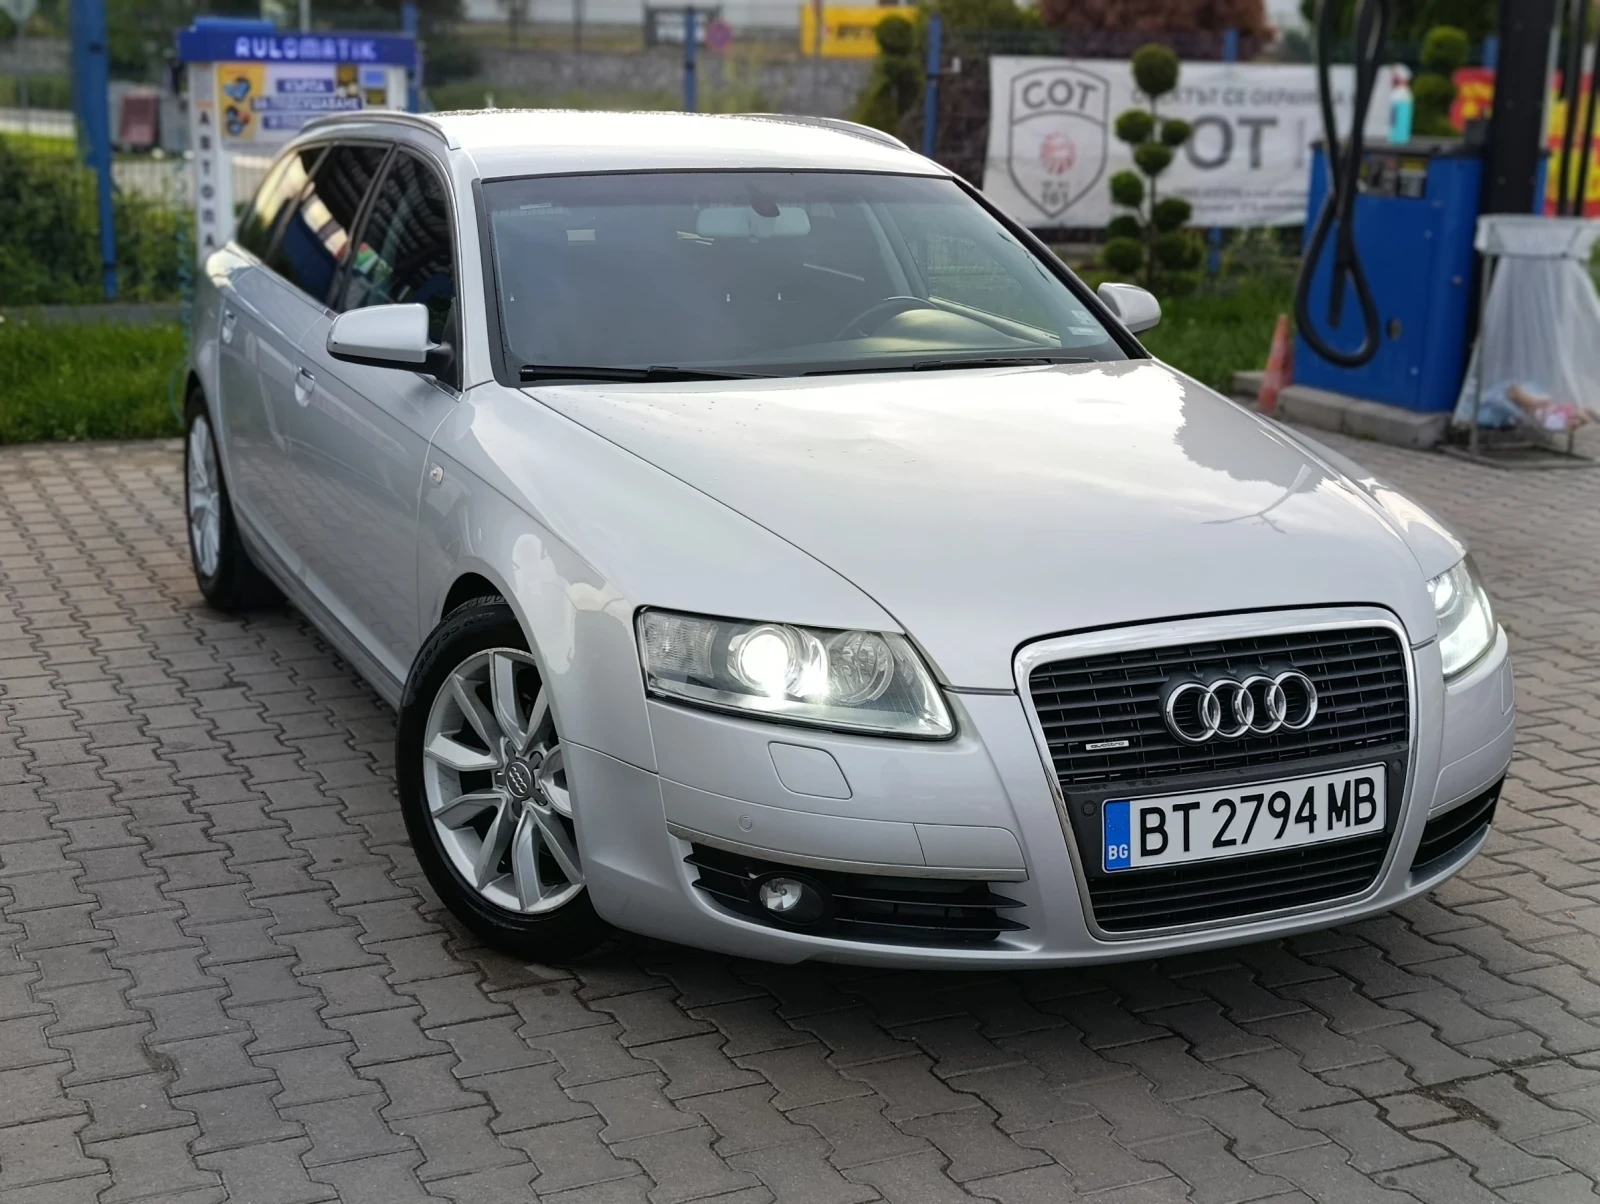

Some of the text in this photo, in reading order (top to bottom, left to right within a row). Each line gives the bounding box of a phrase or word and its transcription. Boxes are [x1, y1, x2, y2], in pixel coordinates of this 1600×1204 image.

[1090, 741, 1125, 749] quattro
[1140, 776, 1377, 858] BT 2794 MB
[1108, 843, 1129, 861] BG
